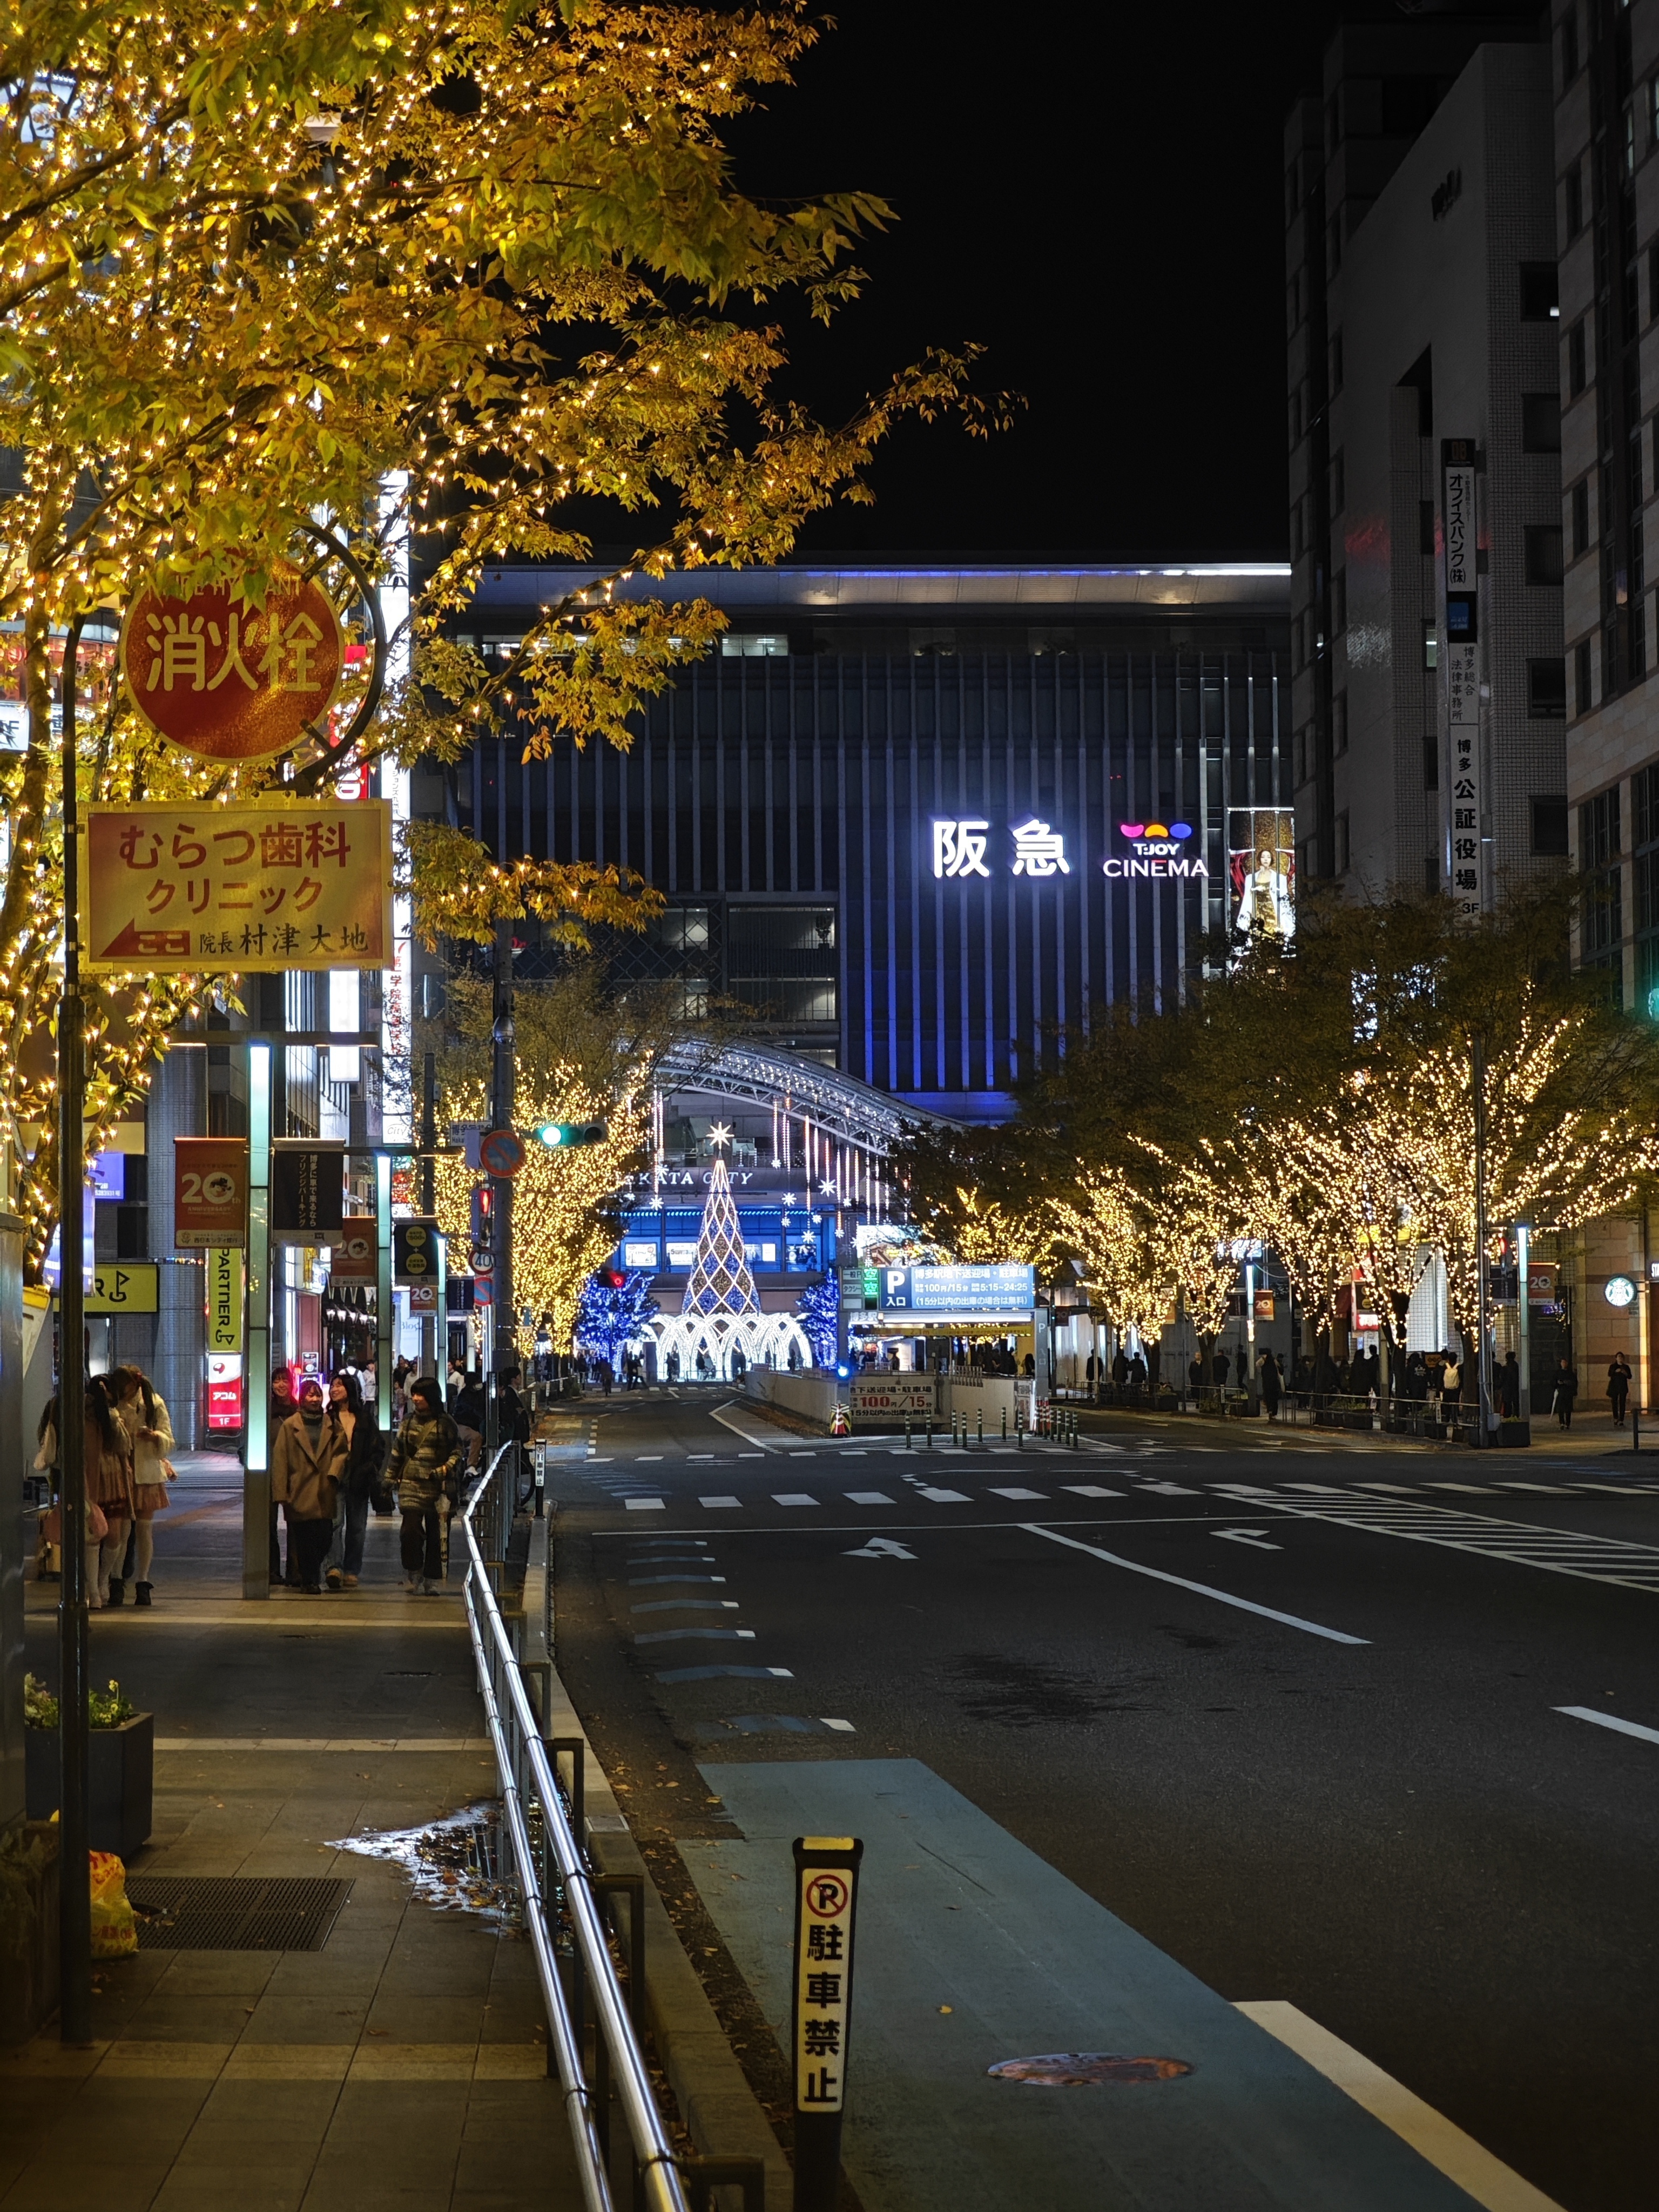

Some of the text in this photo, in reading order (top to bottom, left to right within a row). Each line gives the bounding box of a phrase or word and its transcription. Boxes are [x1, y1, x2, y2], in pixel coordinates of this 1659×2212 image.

[146, 612, 323, 692] 消火栓
[1464, 646, 1475, 696] 博多総合
[1451, 659, 1463, 721] 法律事務所
[1454, 739, 1478, 890] 博多公証役場
[119, 821, 351, 869] むらつ歯科
[933, 818, 1071, 879] 阪急
[1103, 859, 1210, 878] CINEMA
[145, 877, 322, 915] クリニック
[1462, 903, 1480, 914] 3F
[138, 934, 185, 953] ここ
[199, 922, 369, 956] 院長 村津 大地
[703, 1171, 753, 1185] CTY
[475, 1256, 491, 1267] 40
[887, 1271, 906, 1294] P
[886, 1296, 906, 1306] 入口
[1038, 1323, 1046, 1333] P
[212, 1391, 237, 1400] アコム
[219, 1417, 230, 1425] 1F
[804, 1924, 844, 2103] 駐車禁止
